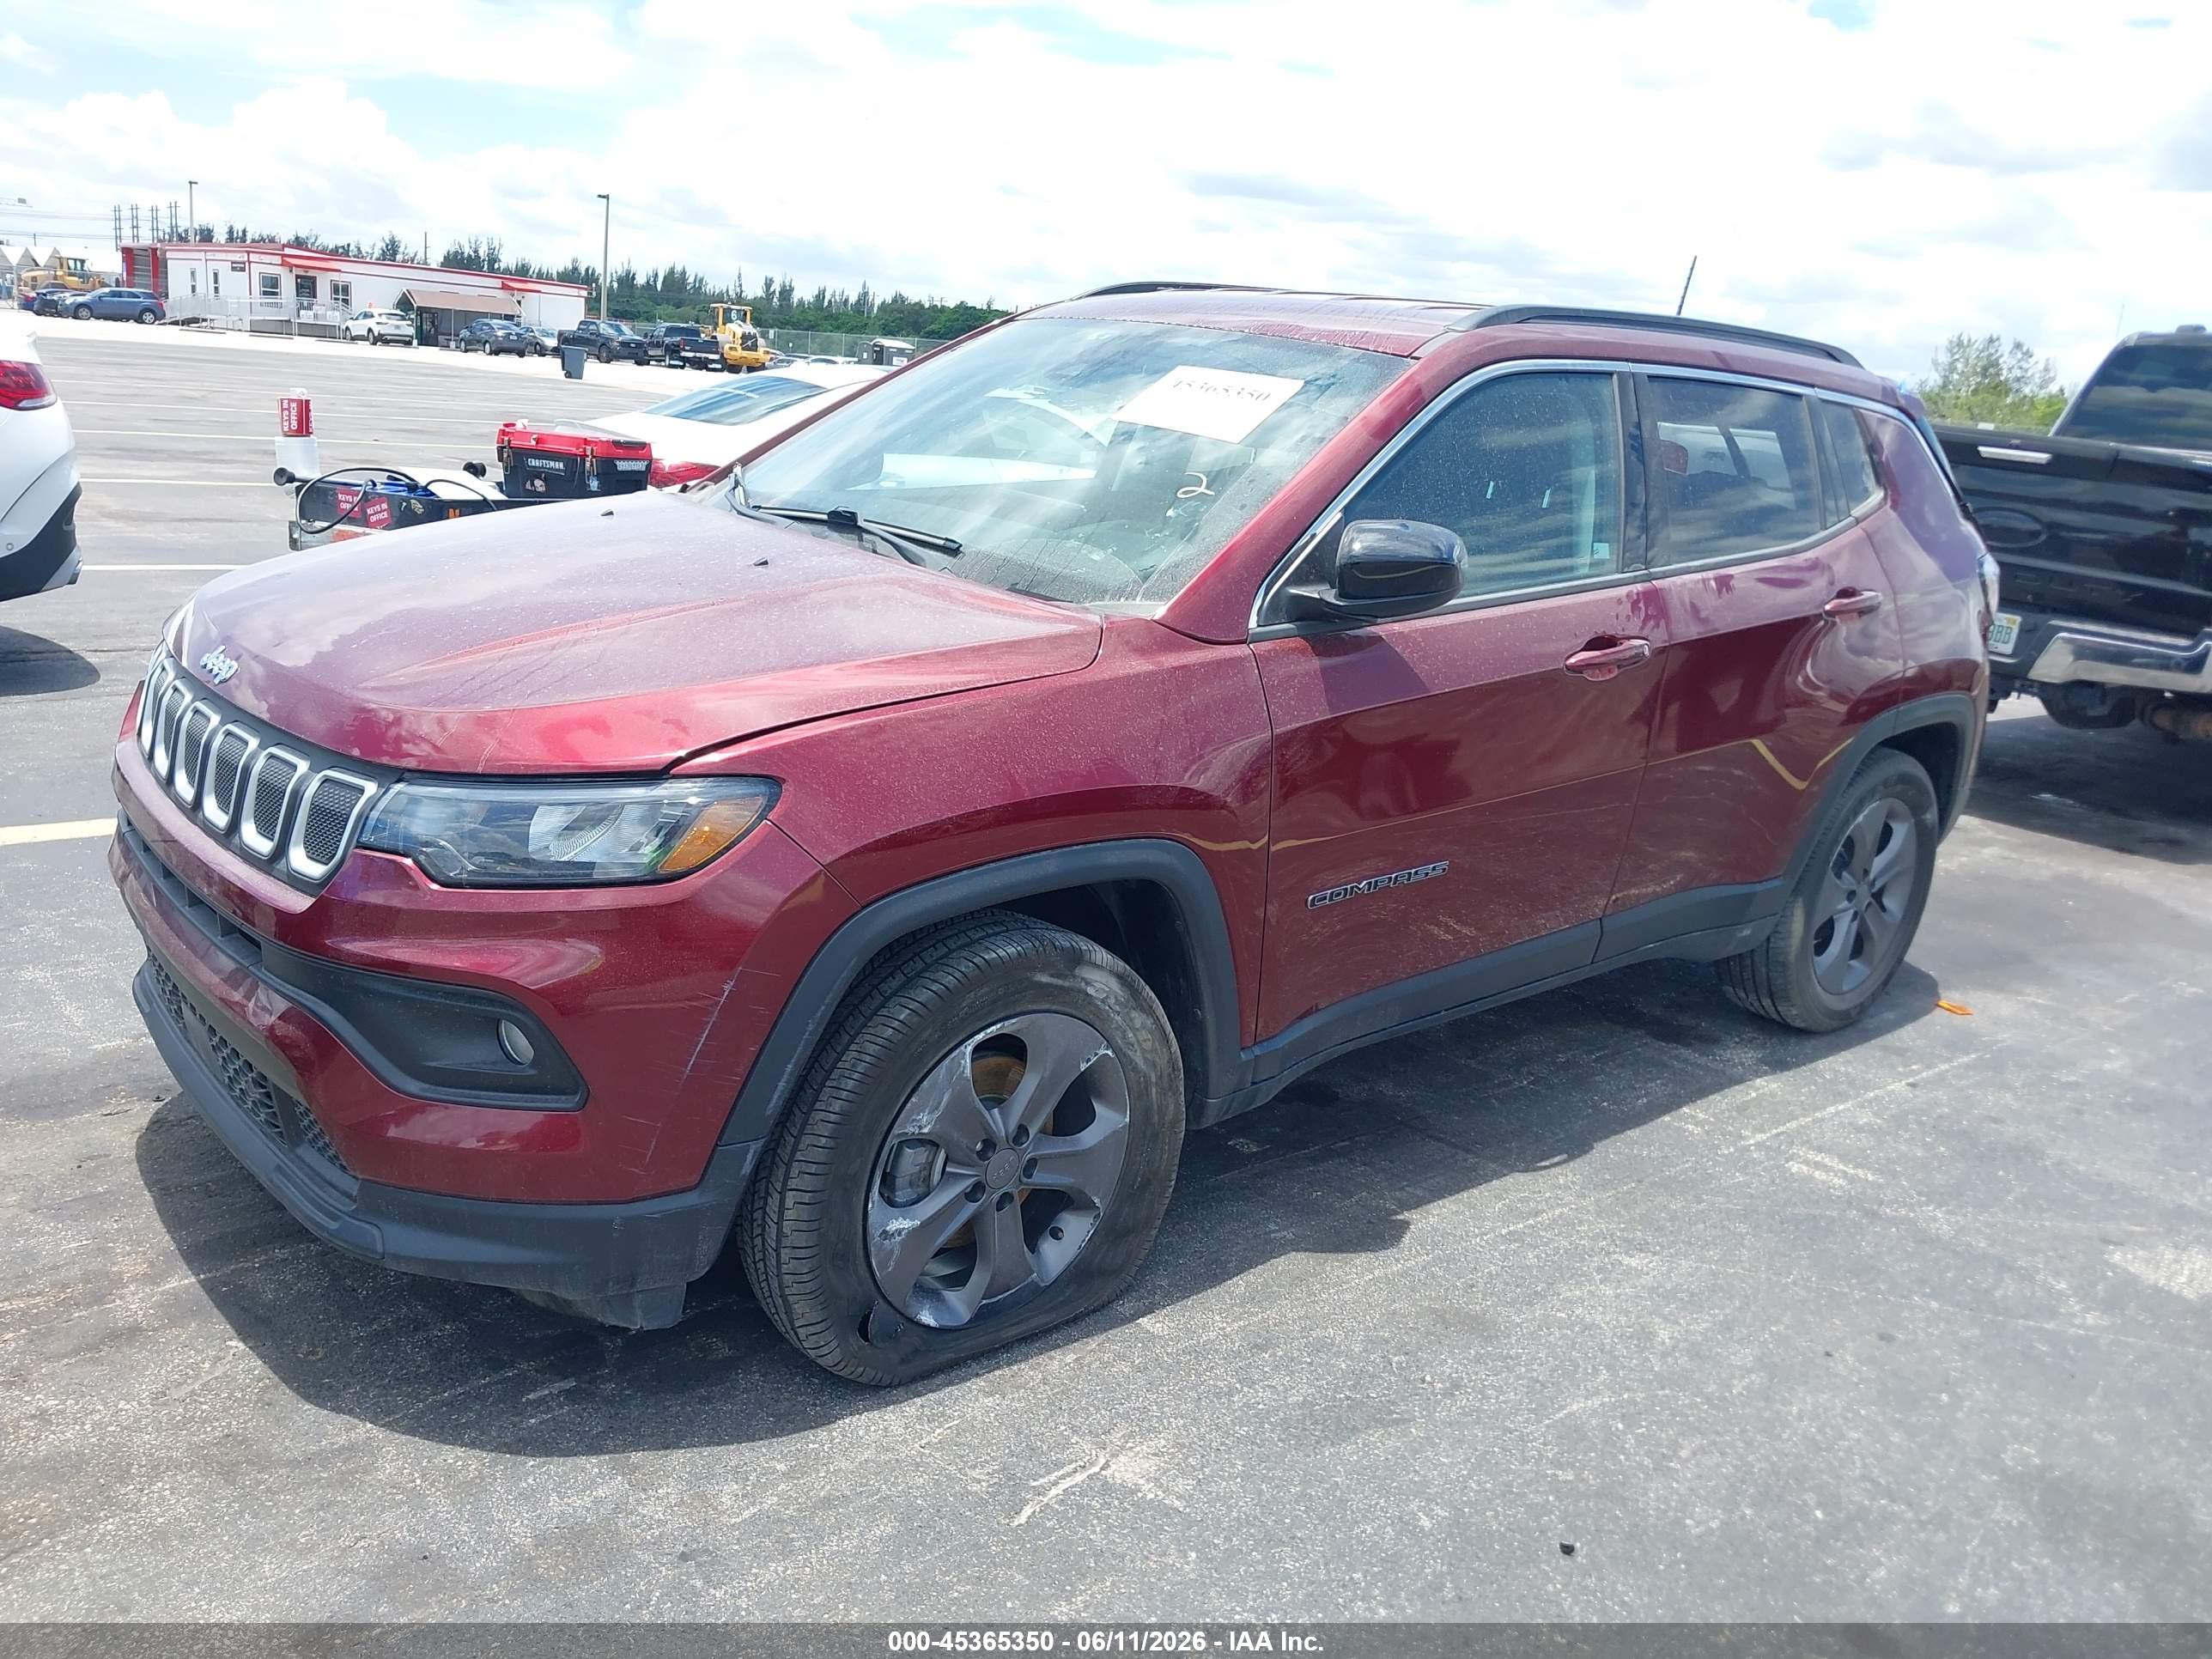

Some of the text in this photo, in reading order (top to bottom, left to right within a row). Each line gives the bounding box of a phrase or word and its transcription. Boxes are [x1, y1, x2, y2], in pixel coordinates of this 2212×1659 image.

[730, 310, 738, 320] 6
[283, 399, 289, 409] IN
[527, 458, 565, 471] CRAFTSMAN
[1176, 471, 1215, 499] 2
[338, 494, 353, 502] KEYS
[366, 504, 381, 515] KEYS
[369, 511, 389, 522] OFFICE
[1308, 860, 1450, 909] COMPASS
